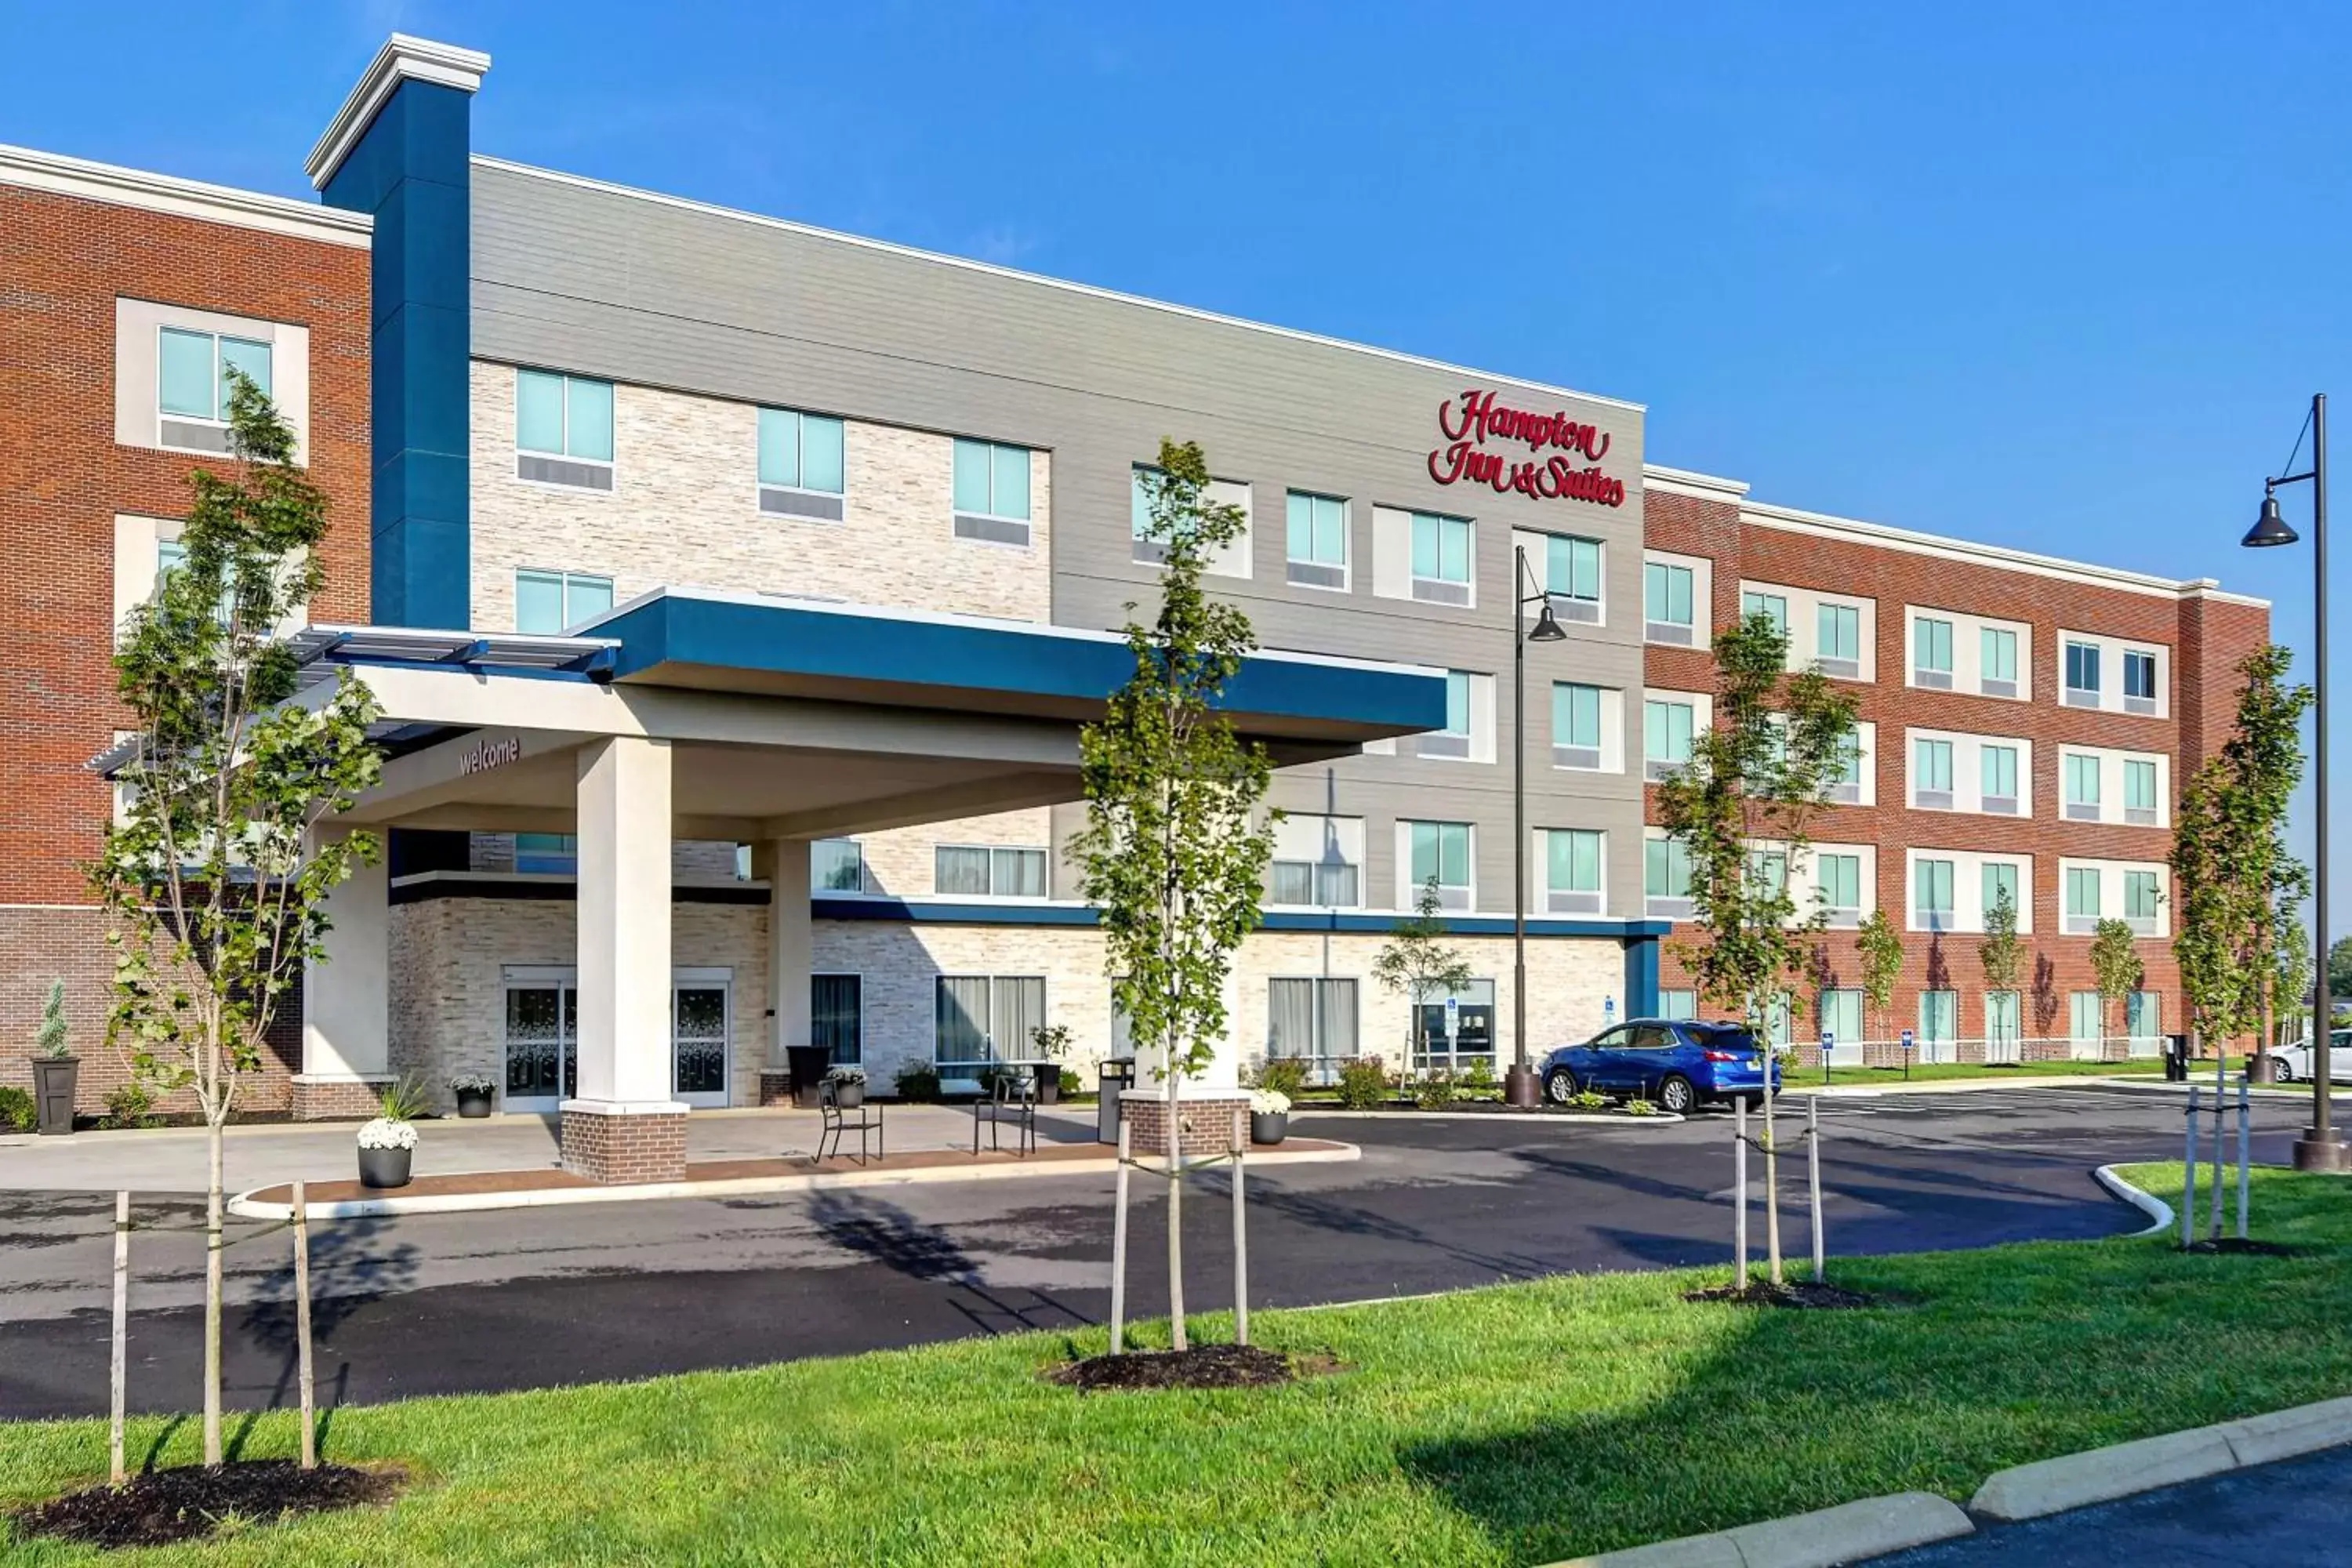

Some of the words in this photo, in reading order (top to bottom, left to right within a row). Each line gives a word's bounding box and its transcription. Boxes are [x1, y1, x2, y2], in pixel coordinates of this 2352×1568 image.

[1439, 390, 1610, 461] Hampton
[1428, 441, 1518, 493] Inn
[1535, 456, 1625, 508] Suites
[460, 736, 520, 776] welcome
